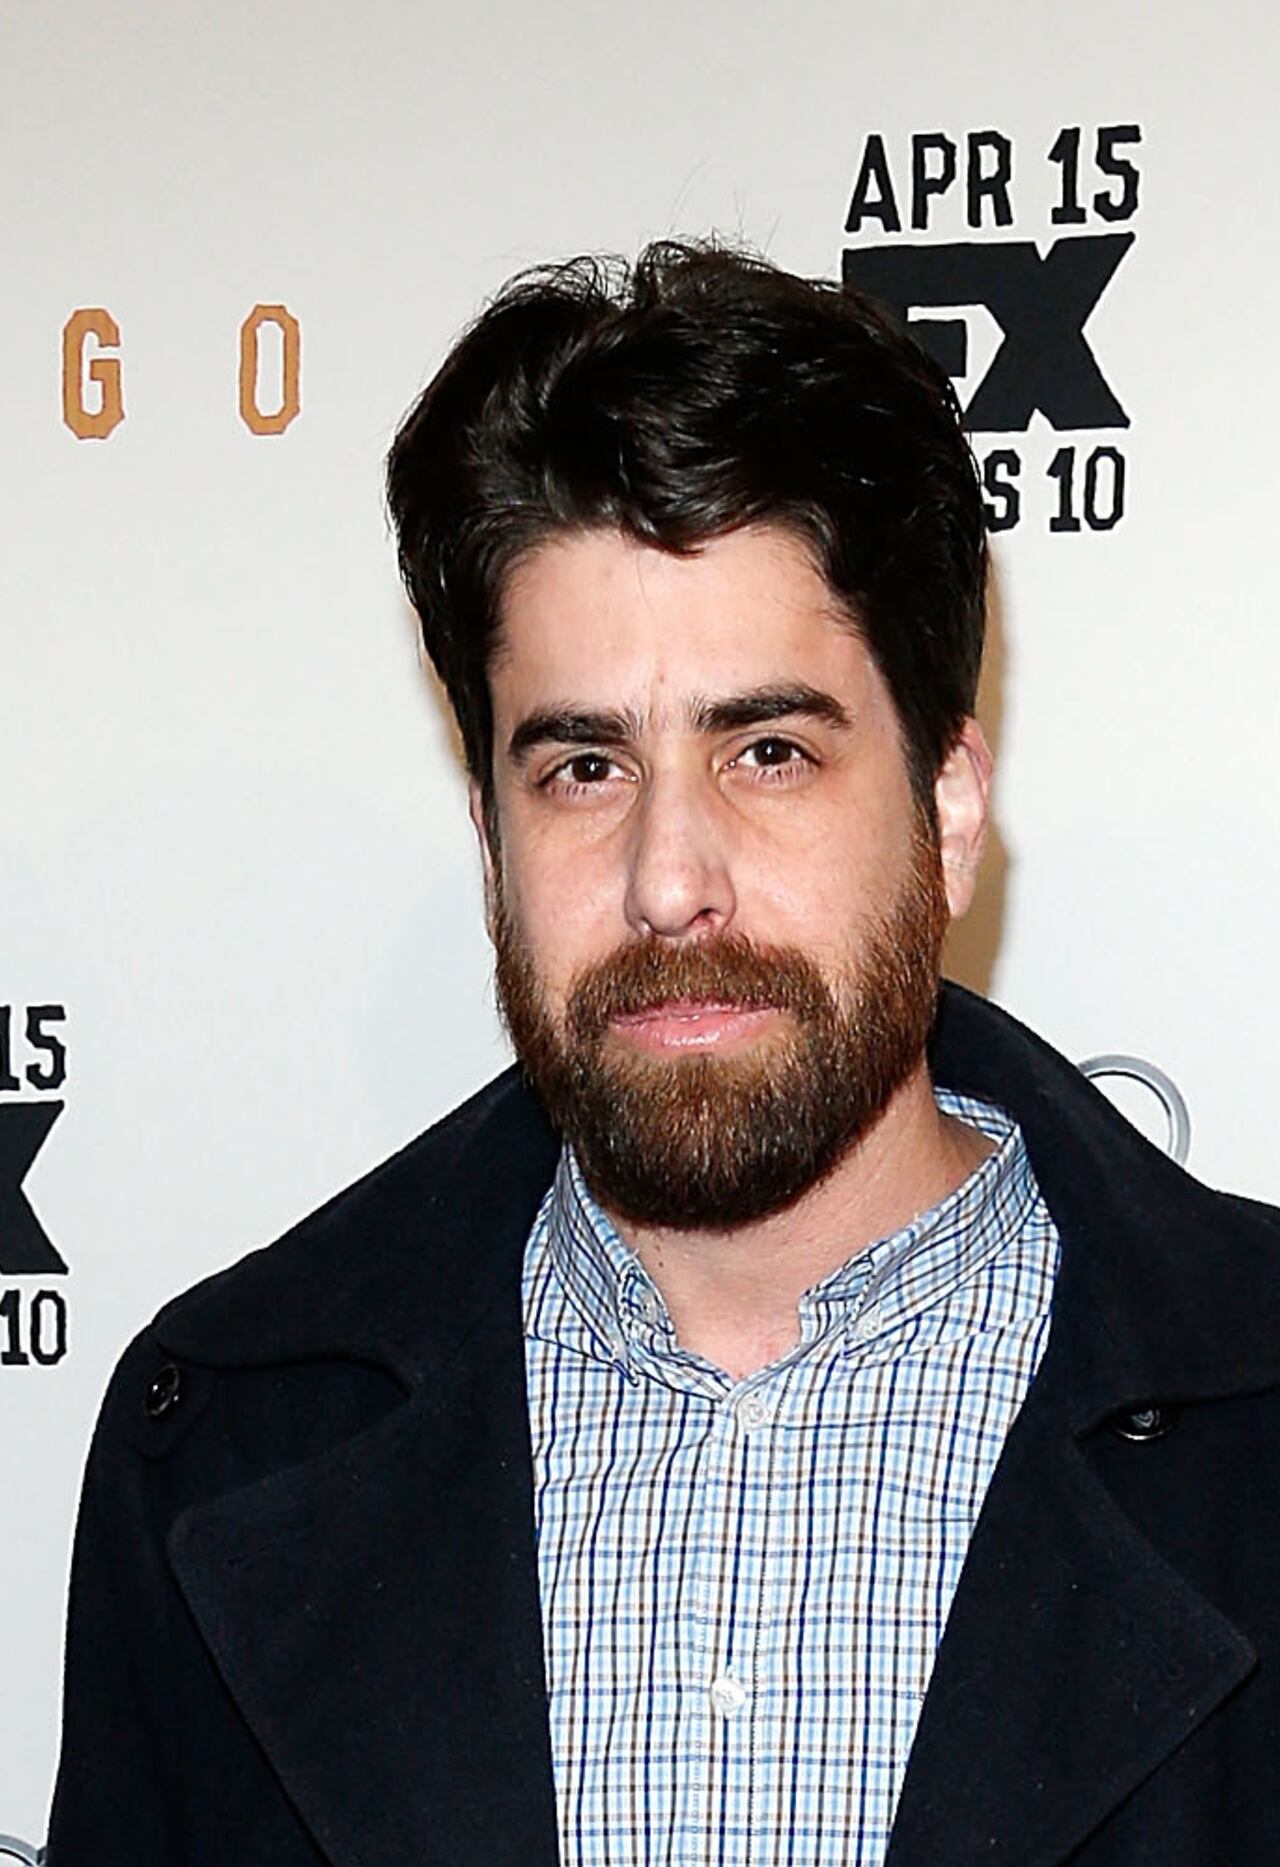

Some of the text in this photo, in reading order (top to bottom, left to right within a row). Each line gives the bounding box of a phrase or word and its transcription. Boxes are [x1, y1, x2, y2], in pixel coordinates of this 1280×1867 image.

[844, 124, 1143, 233] APR 15
[1047, 446, 1125, 532] 10
